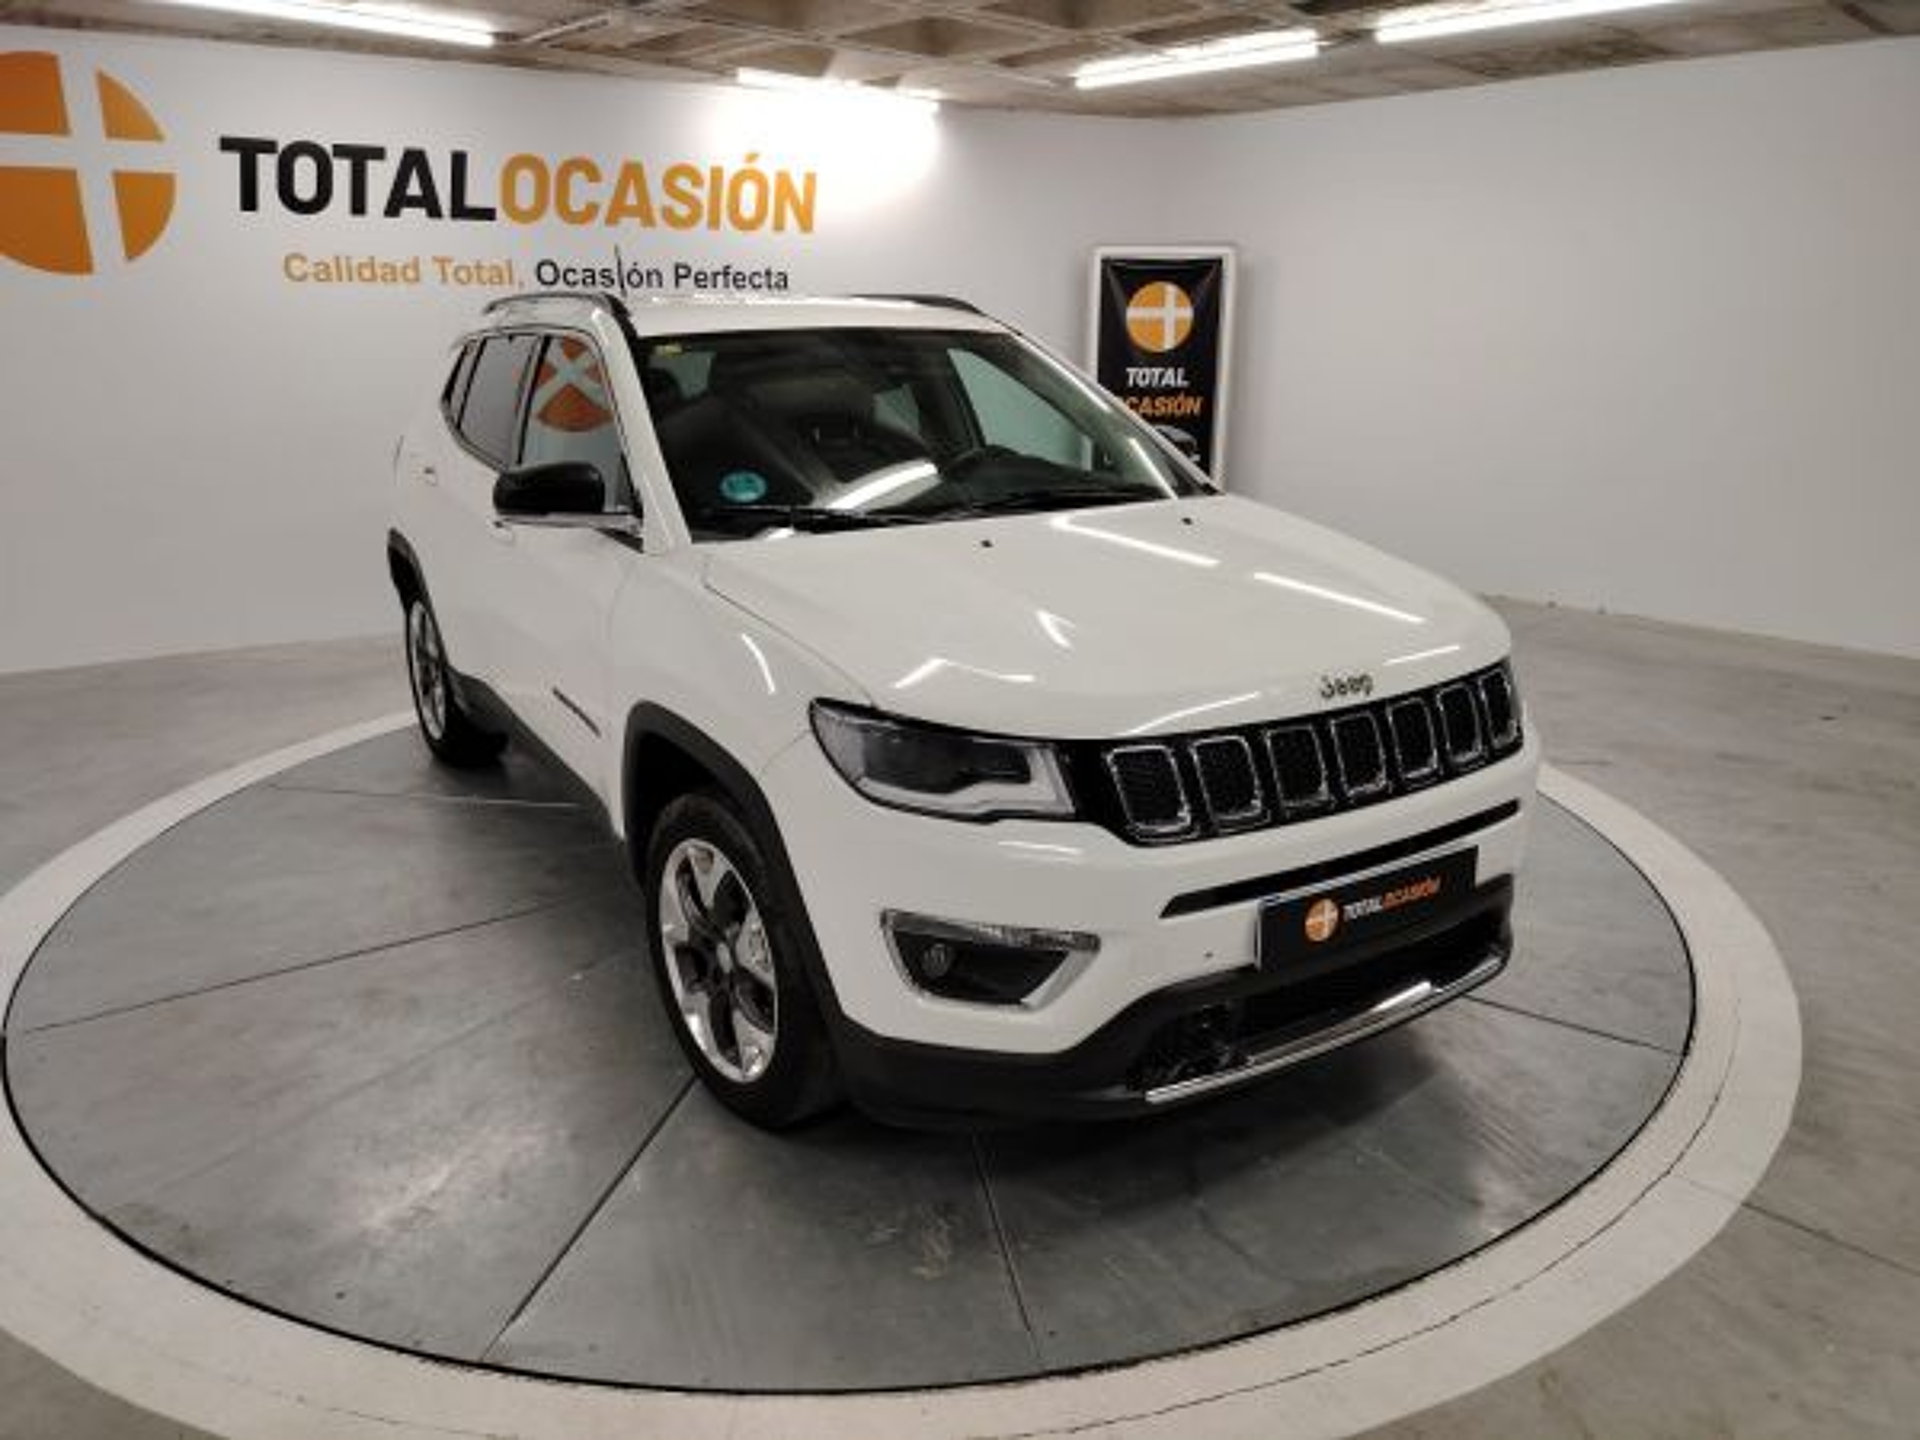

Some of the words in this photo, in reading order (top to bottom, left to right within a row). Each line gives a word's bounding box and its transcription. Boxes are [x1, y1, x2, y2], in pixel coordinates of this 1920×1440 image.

[283, 252, 421, 284] Calidad
[432, 255, 526, 288] Total,
[673, 262, 789, 291] Perfecta
[1125, 367, 1189, 388] TOTAL
[1125, 391, 1203, 416] CASIÓN
[1320, 674, 1374, 698] Jeep
